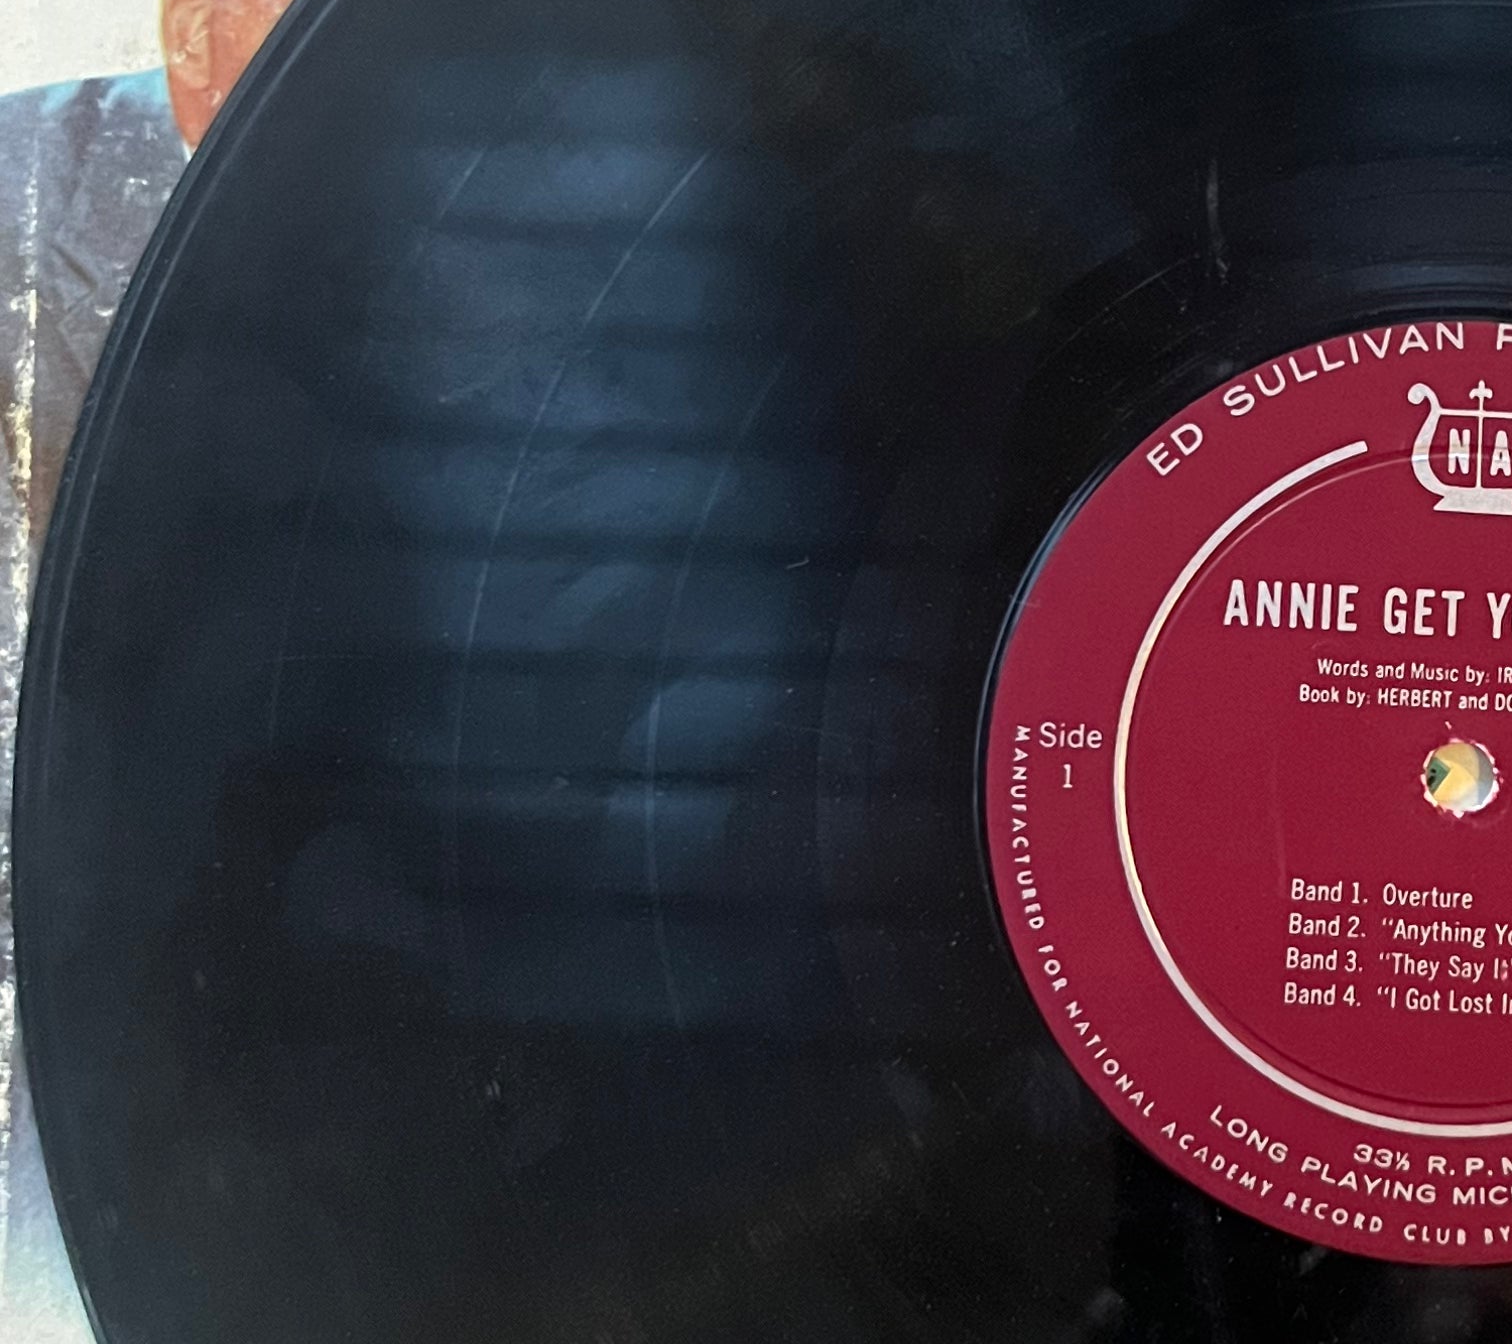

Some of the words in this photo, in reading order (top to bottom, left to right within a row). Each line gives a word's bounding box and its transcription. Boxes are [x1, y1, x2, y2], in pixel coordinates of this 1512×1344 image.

[1145, 422, 1204, 477] ED
[1222, 321, 1465, 417] SULLIVAN
[1222, 578, 1360, 632] ANNIE
[1383, 586, 1466, 638] GET
[1316, 657, 1369, 678] Words
[1374, 662, 1406, 680] and
[1410, 661, 1460, 683] Music
[1298, 683, 1340, 704] Book
[1377, 687, 1453, 709] HERBERT
[1457, 692, 1489, 711] and
[1038, 721, 1103, 749] Side
[1062, 763, 1073, 789] 1
[1290, 877, 1343, 903] Band
[1351, 881, 1369, 905] 1.
[1382, 882, 1474, 910] Overture
[1288, 912, 1341, 937] Band
[1346, 915, 1367, 939] 2.
[1381, 917, 1487, 949] "Anything
[1285, 946, 1338, 972] Band
[1343, 949, 1363, 973] 3.
[1379, 951, 1441, 982] "They
[1447, 954, 1485, 984] Say
[1009, 725, 1045, 930] MANUFACTURED
[1037, 944, 1068, 992] FOR
[1065, 1000, 1155, 1118] NATIONAL
[1160, 1121, 1274, 1197] ACADEMY
[1282, 1191, 1383, 1233] RECORD
[1403, 1223, 1467, 1246] CLUB
[1483, 1225, 1511, 1245] BY
[1283, 981, 1337, 1006] Band
[1342, 984, 1361, 1007] 4.
[1377, 985, 1397, 1009] "I
[1405, 987, 1441, 1012] Got
[1448, 989, 1494, 1015] Lost
[1209, 1104, 1289, 1164] LONG
[1300, 1155, 1437, 1205] PLAYING
